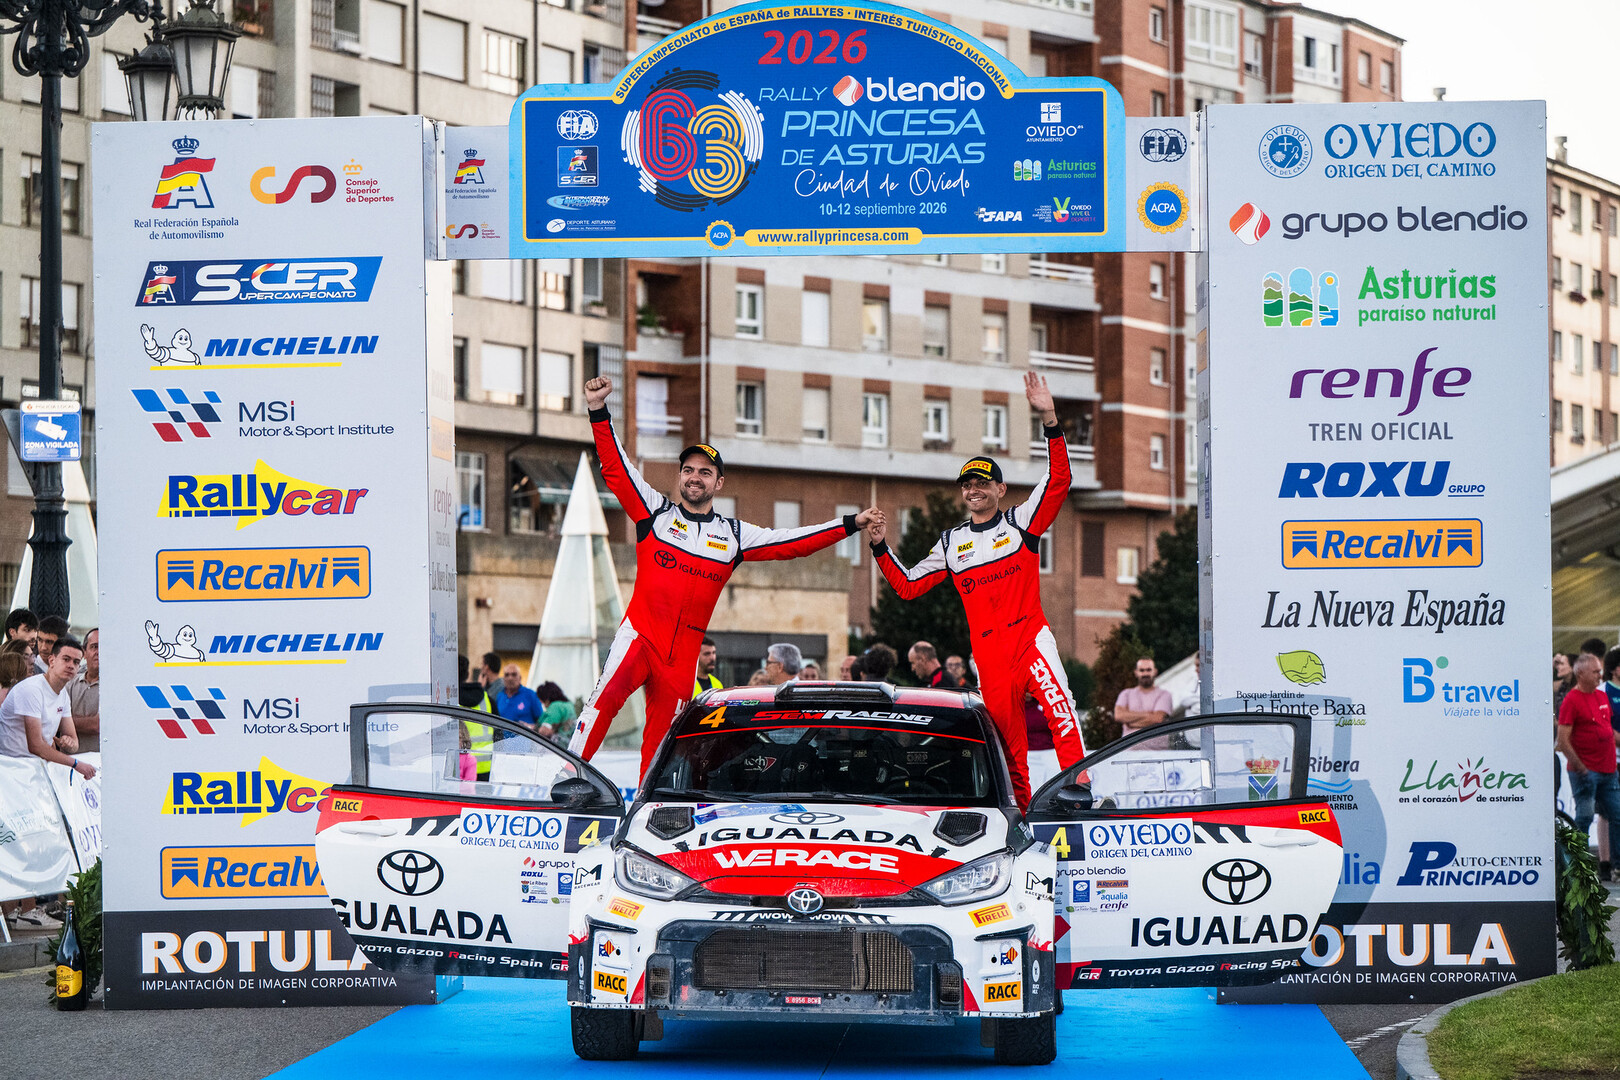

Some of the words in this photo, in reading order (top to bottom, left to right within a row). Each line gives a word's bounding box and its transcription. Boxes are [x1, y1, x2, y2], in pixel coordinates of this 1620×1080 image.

[615, 26, 710, 99] SUPERCAMPEONATO
[713, 22, 726, 32] de
[728, 10, 774, 27] ESPAÑA
[776, 9, 790, 18] de
[793, 8, 844, 17] RALLYES
[854, 9, 903, 27] INTERÉS
[906, 20, 964, 51] TURÍSTICO
[963, 47, 1011, 94] NACIONAL
[758, 29, 867, 65] 2026
[759, 87, 828, 101] RALLY
[866, 76, 985, 102] blendio
[781, 108, 986, 137] PRINCESA
[639, 88, 745, 199] 63
[1266, 126, 1306, 142] OVIEDO
[1324, 121, 1498, 160] OVIEDO
[781, 149, 813, 166] DE
[819, 142, 986, 166] ASTURIAS
[1047, 158, 1096, 171] Asturias
[1324, 163, 1387, 179] ORIGEN
[1392, 163, 1423, 179] DEL
[1426, 162, 1496, 178] CAMINO
[346, 178, 378, 188] Consejo
[346, 186, 380, 196] Superior
[794, 167, 869, 198] Ciudad
[879, 170, 899, 192] de
[909, 167, 970, 197] Oviedo
[346, 195, 356, 203] de
[358, 194, 394, 203] Deportes
[1150, 203, 1176, 213] ACPA
[819, 203, 851, 216] 10-12
[854, 202, 916, 219] septiembre
[919, 202, 947, 215] 2026
[134, 218, 151, 228] Real
[153, 217, 199, 228] Federación
[201, 217, 239, 229] Española
[1282, 212, 1388, 240] grupo
[1397, 205, 1528, 232] blendio
[149, 230, 159, 240] de
[161, 229, 224, 240] Automovilismo
[758, 229, 909, 245] www.rallyprincesa.com
[1358, 265, 1497, 301] Asturias
[1358, 304, 1426, 327] paraíso
[1433, 304, 1496, 322] natural
[204, 335, 380, 357] MICHELIN
[1289, 346, 1472, 416] renfe
[239, 425, 282, 437] Motor
[283, 425, 294, 437] &
[295, 424, 335, 439] Sport
[337, 423, 394, 436] Institute
[1309, 423, 1362, 441] TREN
[1371, 422, 1454, 441] OFICIAL
[45, 441, 79, 449] VIGILADA
[1278, 461, 1451, 498] ROXU
[1448, 484, 1486, 494] GRUPO
[168, 473, 369, 516] Rallycar
[958, 541, 973, 552] RACC
[1321, 529, 1443, 559] Recalvi
[198, 557, 329, 591] Recalvi
[679, 563, 722, 582] IGUALADA
[977, 564, 1021, 586] IGUALADA
[1261, 591, 1301, 628] La
[1307, 590, 1395, 628] Nueva
[1401, 589, 1506, 634] España
[209, 632, 384, 654] MICHELIN
[1403, 657, 1435, 703] B
[1442, 679, 1520, 703] travel
[1270, 699, 1319, 716] Fonte
[1323, 698, 1366, 716] Baxa
[1443, 706, 1480, 719] Viájate
[1484, 707, 1494, 716] la
[1496, 706, 1520, 716] vida
[699, 706, 728, 728] 4
[1335, 717, 1367, 728] Luarca
[243, 723, 287, 735] Motor
[288, 723, 298, 735] &
[300, 721, 340, 736] Sport
[334, 800, 360, 812] RACC
[1412, 795, 1420, 803] el
[1422, 795, 1458, 803] corazón
[1476, 795, 1486, 803] de
[1489, 795, 1525, 803] asturias
[1301, 811, 1327, 823] RACC
[463, 812, 562, 839] OVIEDO
[578, 820, 601, 847] 4
[460, 836, 496, 848] ORIGEN
[498, 838, 517, 850] DEL
[518, 840, 559, 851] CAMINO
[698, 828, 925, 853] IGUALADA
[1050, 826, 1071, 858] 4
[1089, 822, 1191, 847] OVIEDO
[713, 849, 899, 874] WERACE
[1090, 847, 1129, 859] ORIGEN
[1131, 847, 1150, 859] DEL
[1151, 846, 1192, 857] CAMINO
[1452, 856, 1543, 867] AUTO-CENTER
[203, 855, 325, 888] Recalv
[539, 860, 569, 869] grupo
[1087, 866, 1126, 875] blendio
[1100, 900, 1128, 911] renfe
[1101, 892, 1128, 901] aqualia
[609, 897, 640, 918] PIRELLI
[759, 912, 794, 920] WOW
[809, 913, 846, 921] WOW
[974, 904, 1009, 924] PIRELLI
[330, 898, 513, 945] GUALADA
[1301, 923, 1516, 967] OTULA
[397, 946, 443, 958] GAZOO
[448, 951, 495, 965] Racing
[500, 956, 543, 968] Spain
[1079, 969, 1101, 980] GR
[1109, 967, 1162, 977] TOYOTA
[1165, 963, 1215, 975] GAZOO
[1220, 960, 1267, 972] Racing
[1356, 972, 1372, 984] DE
[1376, 972, 1426, 984] IMAGEN
[1429, 971, 1518, 984] CORPORATIVA
[142, 976, 236, 991] IMPLANTACIÓN
[239, 978, 254, 990] DE
[258, 977, 307, 989] IMAGEN
[310, 976, 397, 989] CORPORATIVA
[598, 973, 625, 992] RACC
[988, 983, 1017, 1000] RACC
